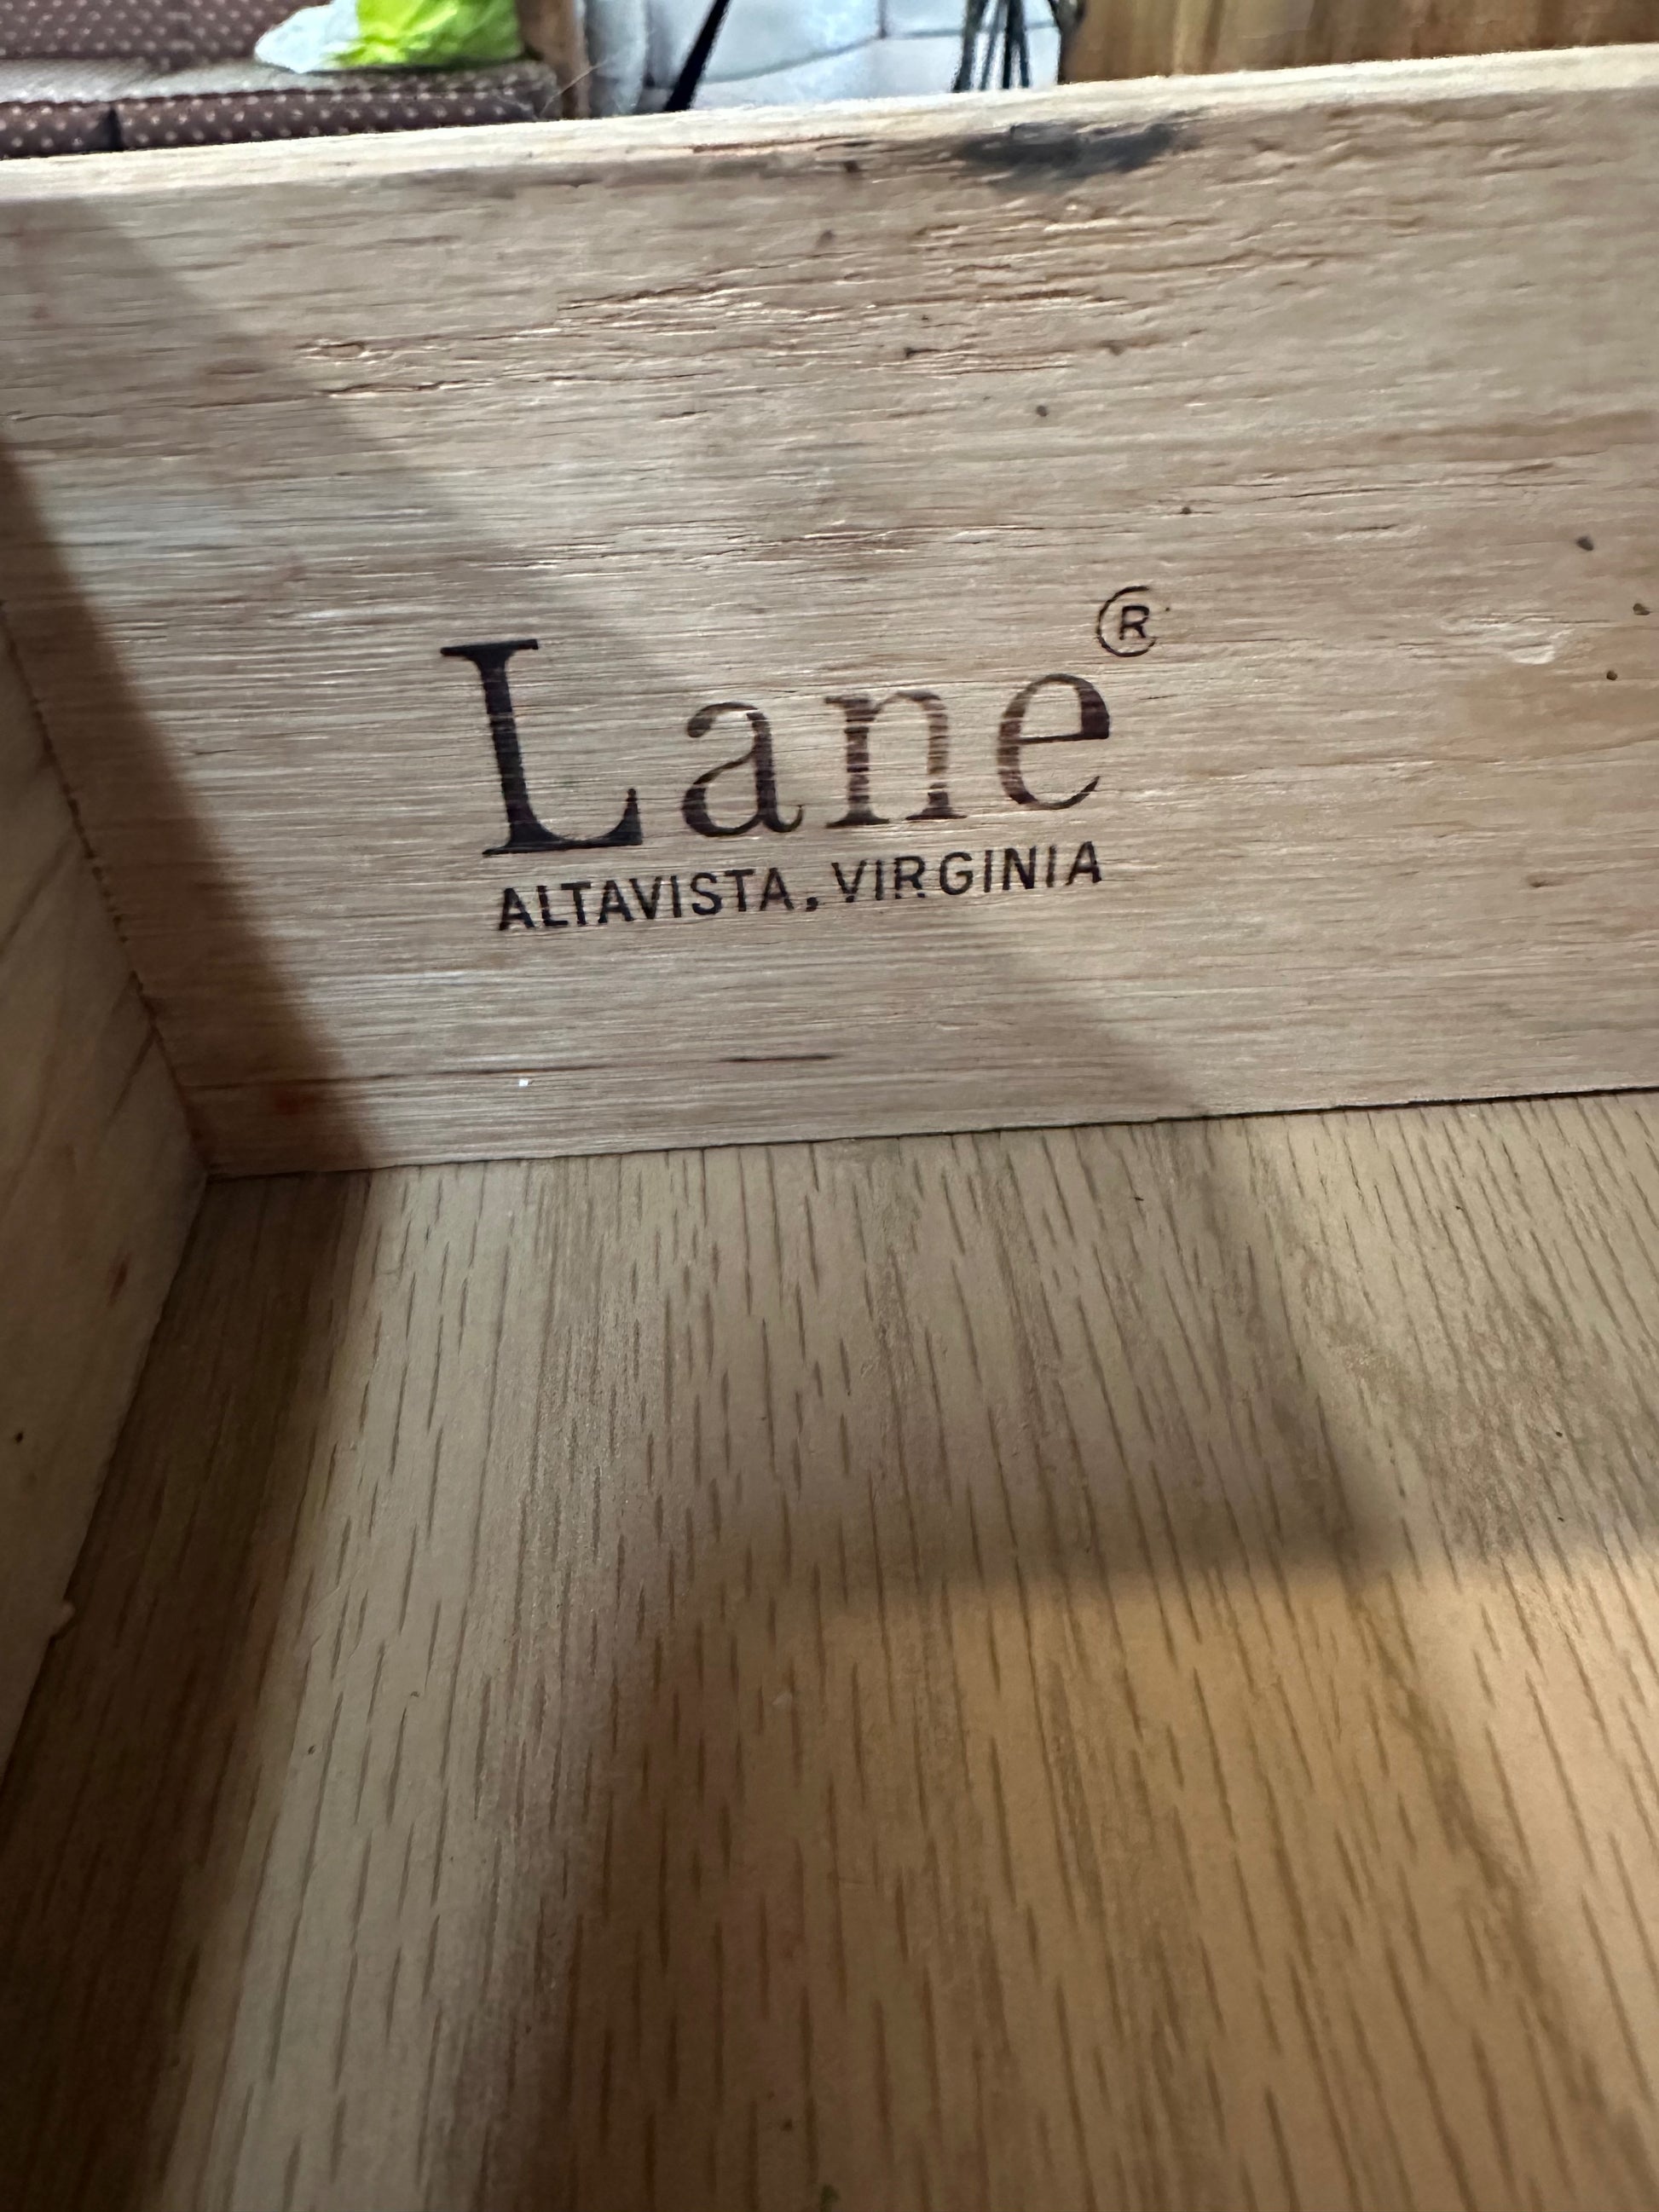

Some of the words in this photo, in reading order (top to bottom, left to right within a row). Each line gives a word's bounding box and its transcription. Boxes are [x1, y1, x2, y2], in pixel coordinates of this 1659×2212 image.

[441, 638, 1111, 855] Lane
[498, 867, 818, 932] ALTAVISTA,
[832, 840, 1102, 904] VIRGINIA
